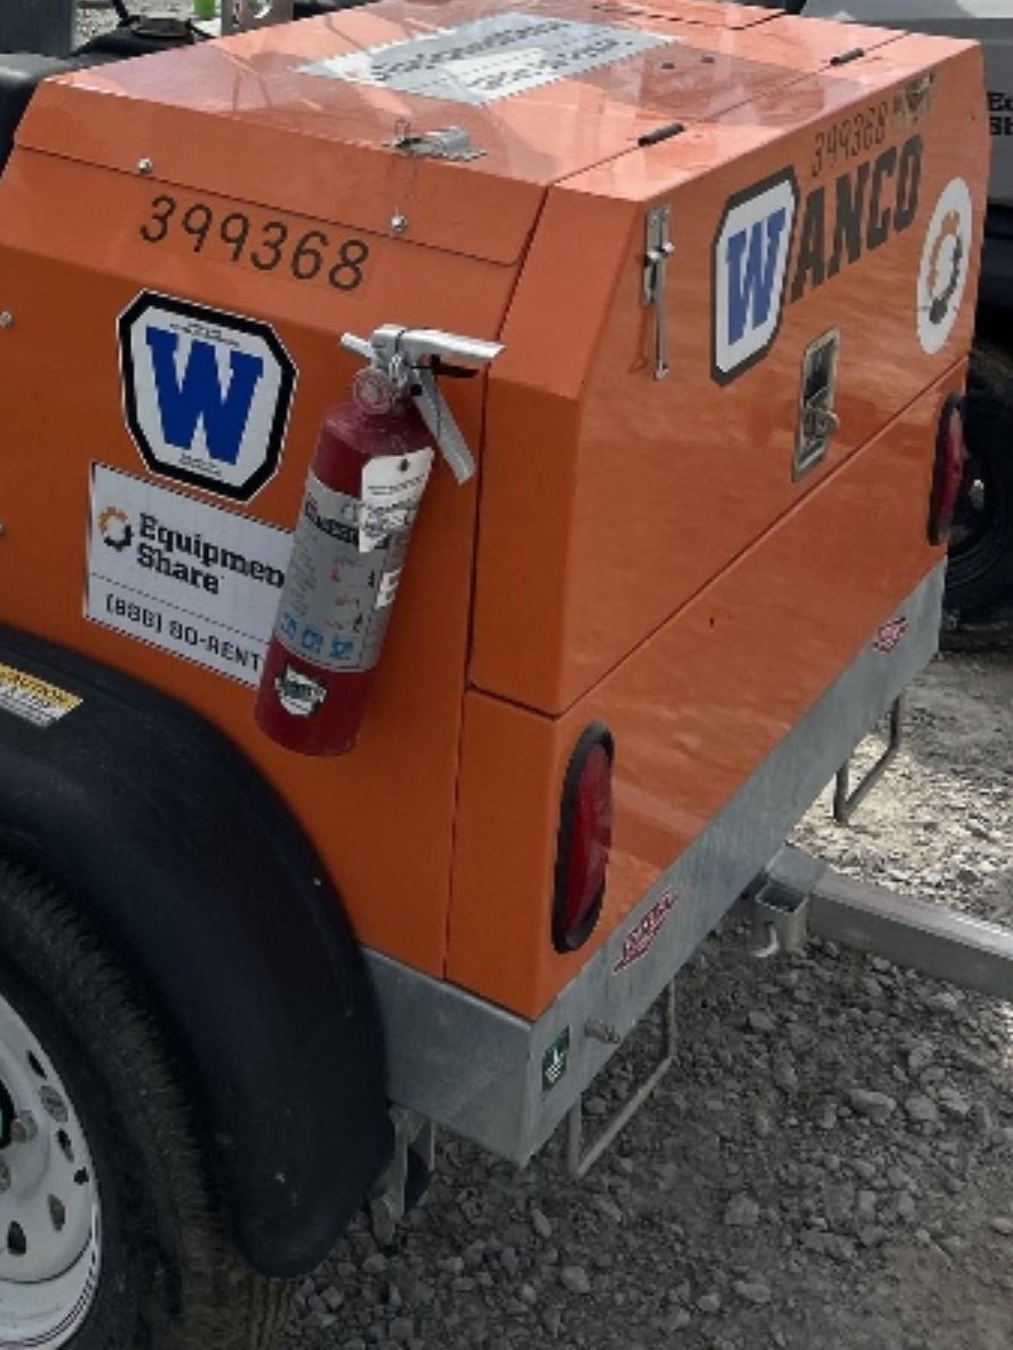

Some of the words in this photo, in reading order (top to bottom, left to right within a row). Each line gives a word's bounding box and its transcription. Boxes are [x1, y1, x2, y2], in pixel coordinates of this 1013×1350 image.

[138, 194, 370, 291] 399368
[145, 326, 264, 465] W
[136, 542, 220, 595] Share
[138, 511, 286, 590] Equipmen
